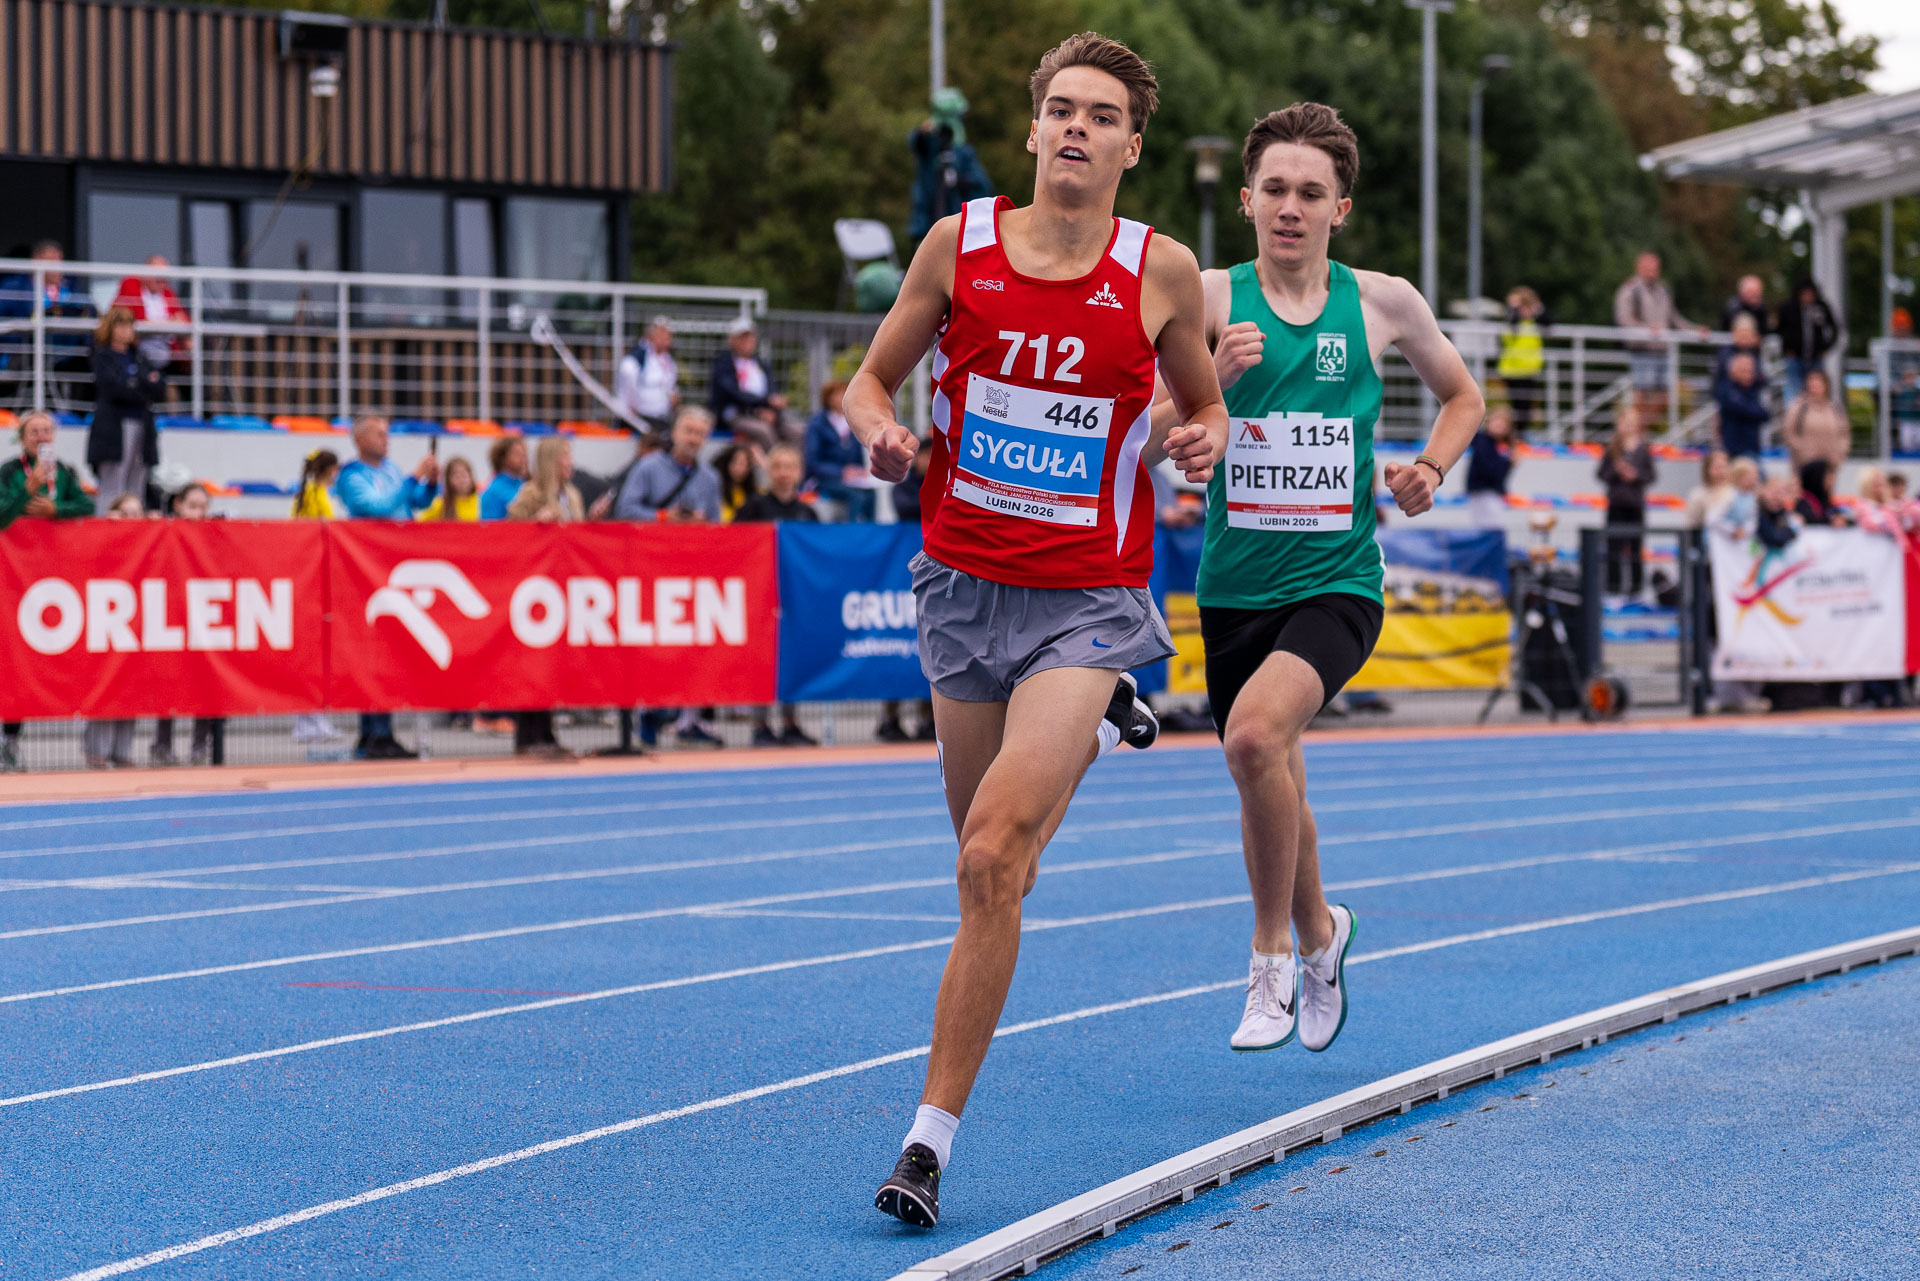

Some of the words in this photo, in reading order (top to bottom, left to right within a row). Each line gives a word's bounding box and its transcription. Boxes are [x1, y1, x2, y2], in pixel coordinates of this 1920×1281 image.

[972, 278, 1005, 292] esa
[998, 330, 1085, 383] 712
[1044, 402, 1100, 430] 446
[1290, 425, 1350, 447] 1154
[970, 430, 1088, 480] SYGUŁA
[1231, 464, 1348, 490] PIETRZAK
[987, 481, 999, 489] PZLA
[1000, 483, 1032, 495] Mistrzostwa
[1032, 490, 1048, 498] Polski
[1009, 490, 1034, 501] JANUSZA
[985, 495, 1021, 511] LUBIN
[1023, 504, 1054, 518] 2026
[1259, 517, 1290, 526] LUBIN
[1292, 518, 1319, 527] 2026
[17, 577, 294, 654] ORLEN
[509, 576, 747, 648] ORLEN
